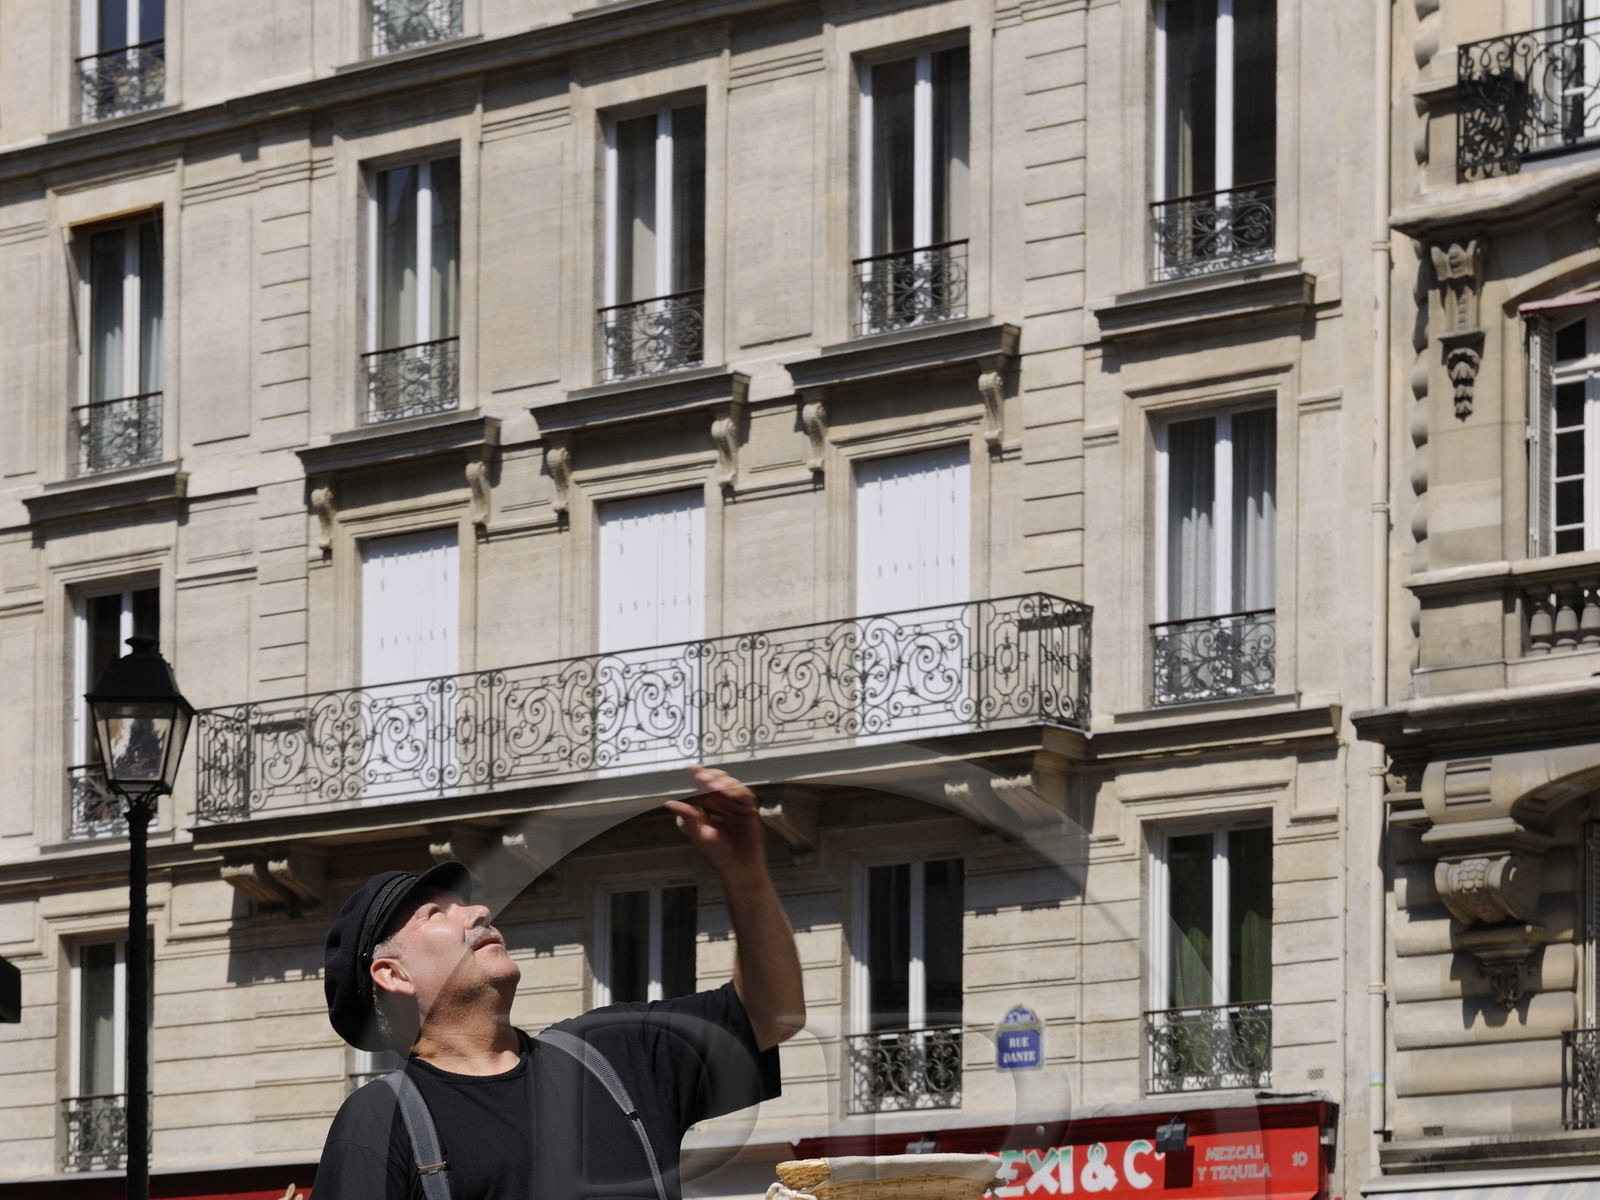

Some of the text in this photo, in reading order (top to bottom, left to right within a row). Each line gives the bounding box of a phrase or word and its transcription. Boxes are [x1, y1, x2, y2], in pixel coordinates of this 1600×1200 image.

[1008, 1036, 1029, 1049] RUE
[1003, 1050, 1036, 1063] DANTE
[1205, 1144, 1264, 1162] MEZCAL
[1292, 1151, 1309, 1167] 10
[984, 1145, 1074, 1199] EXI
[1080, 1142, 1119, 1193] &
[1197, 1163, 1272, 1183] Y TEQUILA
